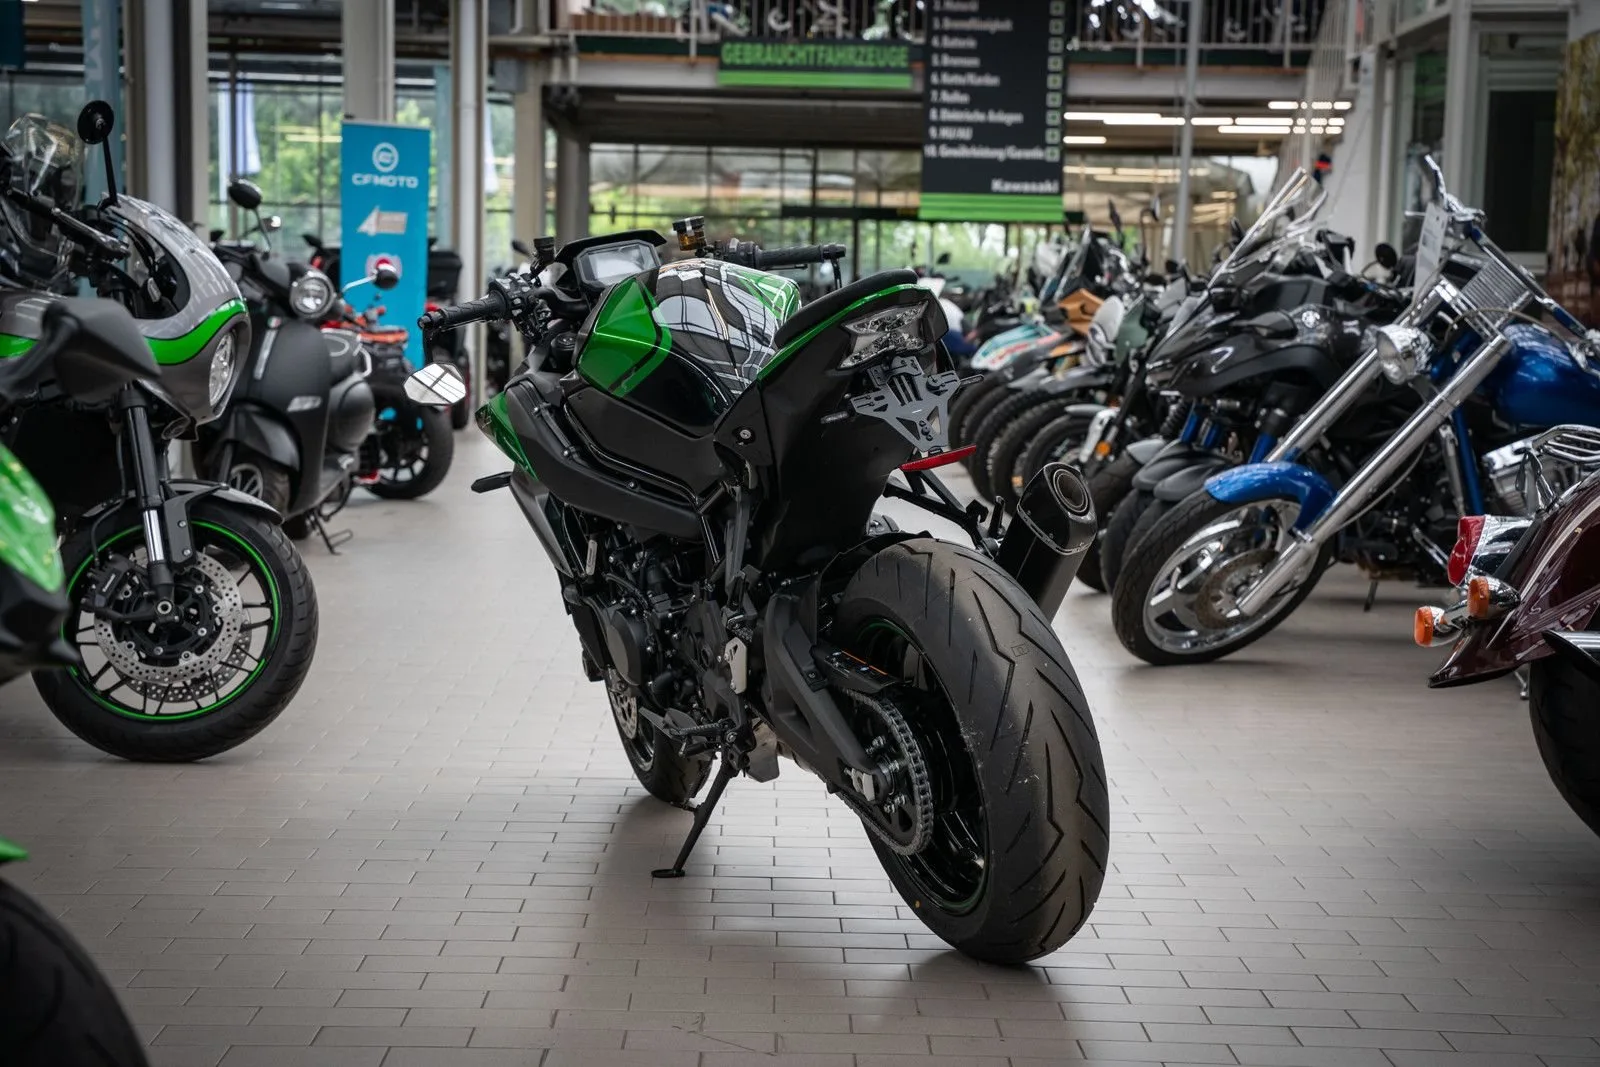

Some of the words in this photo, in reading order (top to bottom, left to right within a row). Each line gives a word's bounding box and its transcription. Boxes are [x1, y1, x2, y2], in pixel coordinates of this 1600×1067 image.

[721, 42, 909, 67] GEBRAUCHTFAHRZEUGE
[351, 172, 419, 189] CFMOTO
[990, 178, 1059, 193] Kawasaki
